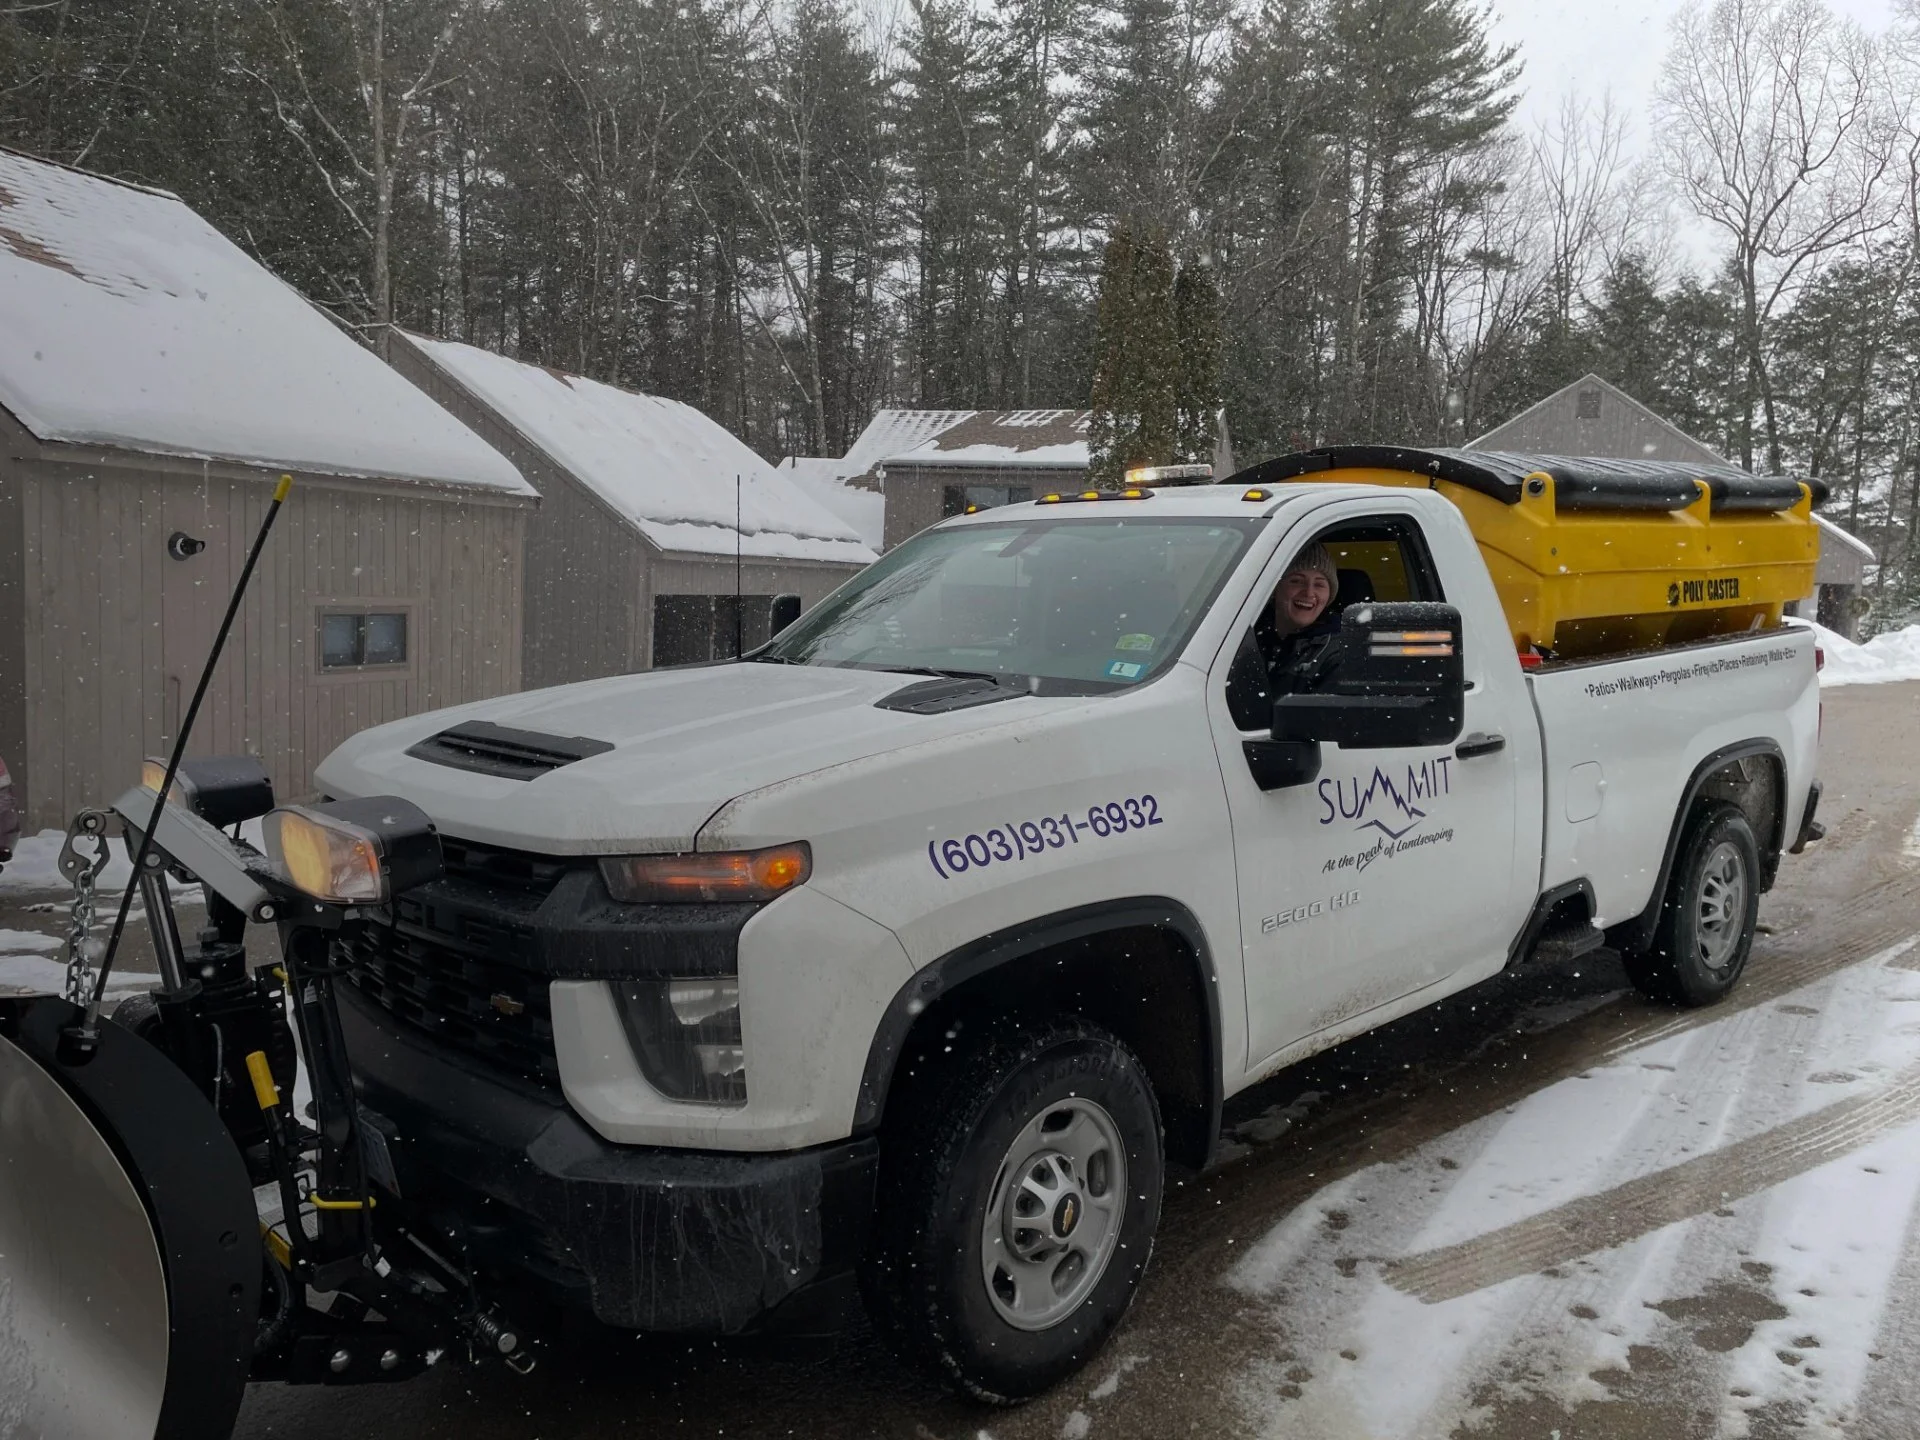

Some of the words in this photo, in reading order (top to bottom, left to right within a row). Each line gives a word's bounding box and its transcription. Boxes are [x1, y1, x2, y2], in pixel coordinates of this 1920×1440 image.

[1683, 580, 1704, 602] POLY
[1707, 578, 1739, 600] CASTER
[1588, 681, 1615, 698] Patios
[1617, 674, 1658, 692] Walkways
[1660, 667, 1691, 684] Pergolas
[1318, 756, 1452, 825] SUMMIT
[928, 794, 1163, 880] (603)931-6932
[1322, 859, 1336, 874] At
[1338, 855, 1354, 868] the
[1384, 847, 1395, 858] of
[1396, 828, 1454, 851] Landscaping
[1261, 900, 1325, 934] 2500
[1330, 889, 1360, 911] HD
